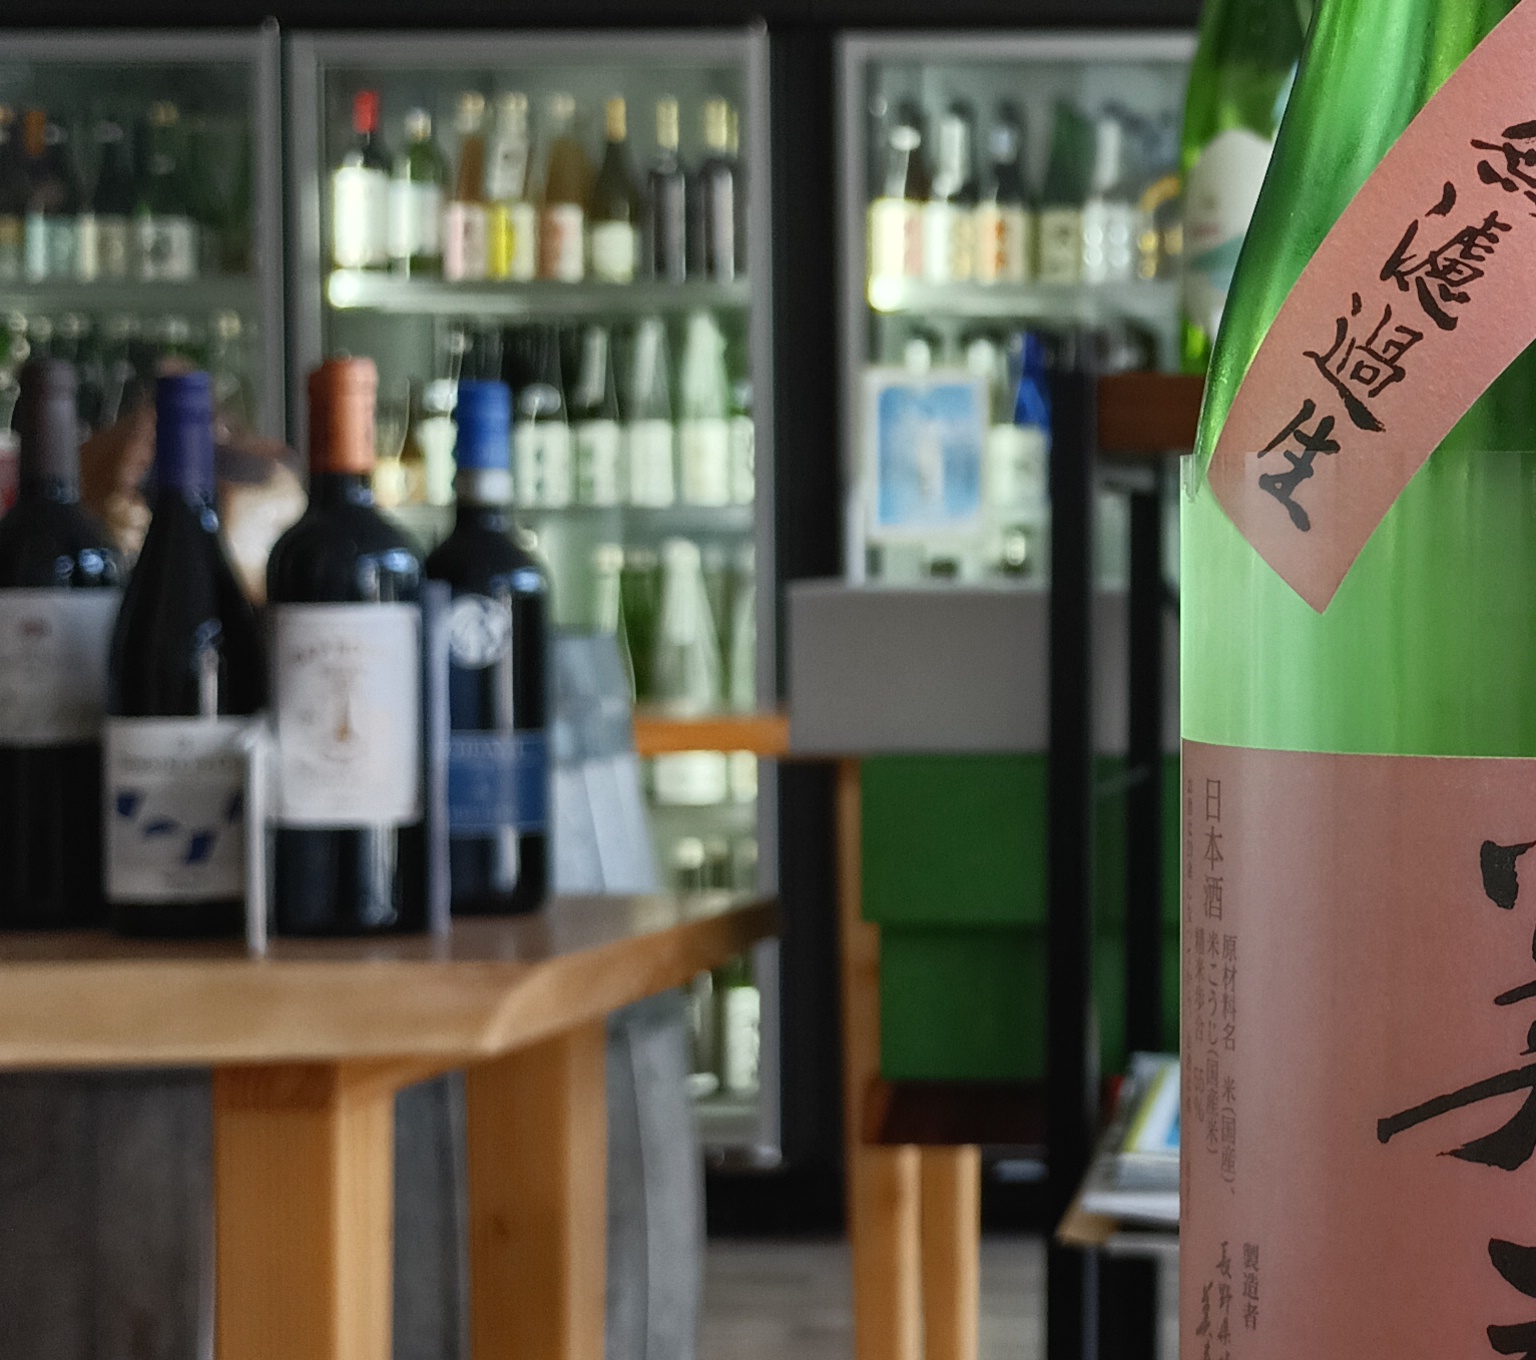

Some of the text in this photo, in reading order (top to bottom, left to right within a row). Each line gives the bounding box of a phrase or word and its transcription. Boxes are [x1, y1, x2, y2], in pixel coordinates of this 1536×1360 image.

[1203, 777, 1224, 922] 日本酒
[1221, 933, 1238, 1053] 原材料名
[1242, 1242, 1260, 1331] 製造者
